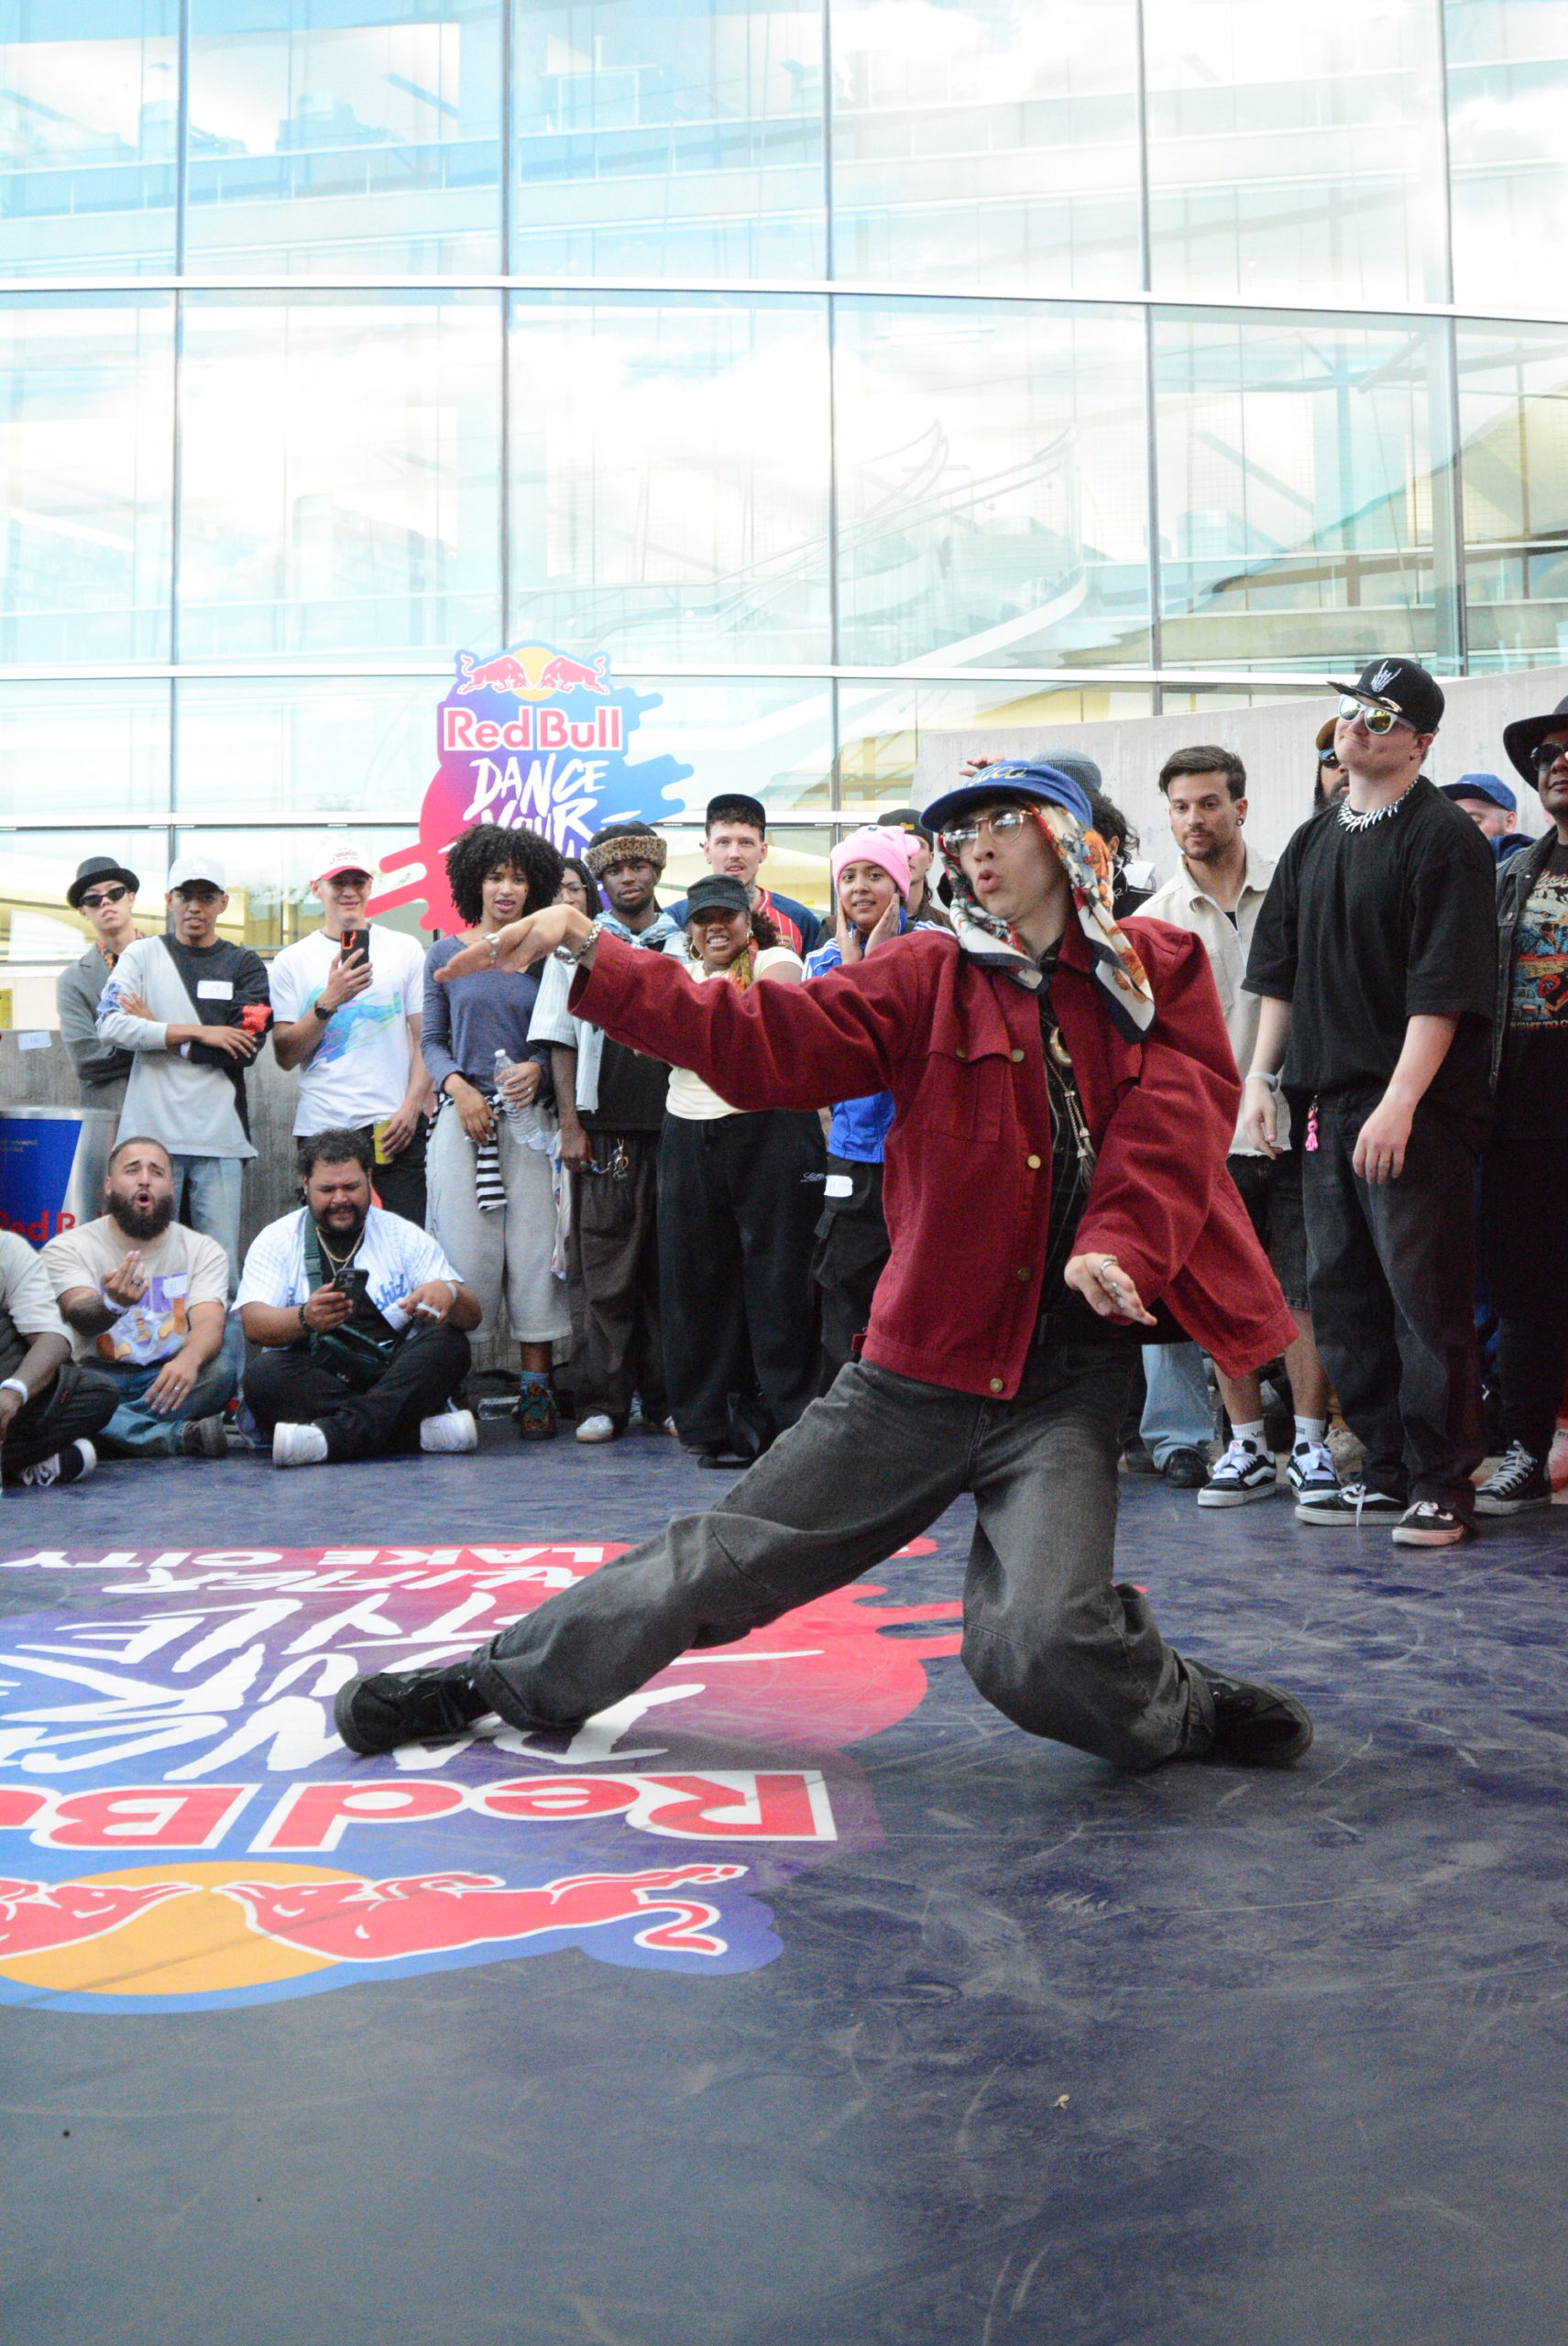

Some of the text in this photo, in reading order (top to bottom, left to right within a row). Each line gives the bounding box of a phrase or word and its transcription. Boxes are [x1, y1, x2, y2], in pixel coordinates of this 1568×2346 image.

[446, 708, 620, 749] Red Bull
[463, 753, 610, 821] DANCE
[0, 1546, 604, 1569] LAKE CITY
[103, 1566, 579, 1594] ALIFIER
[16, 1592, 536, 1673] TYLE
[264, 1772, 825, 1849] Red
